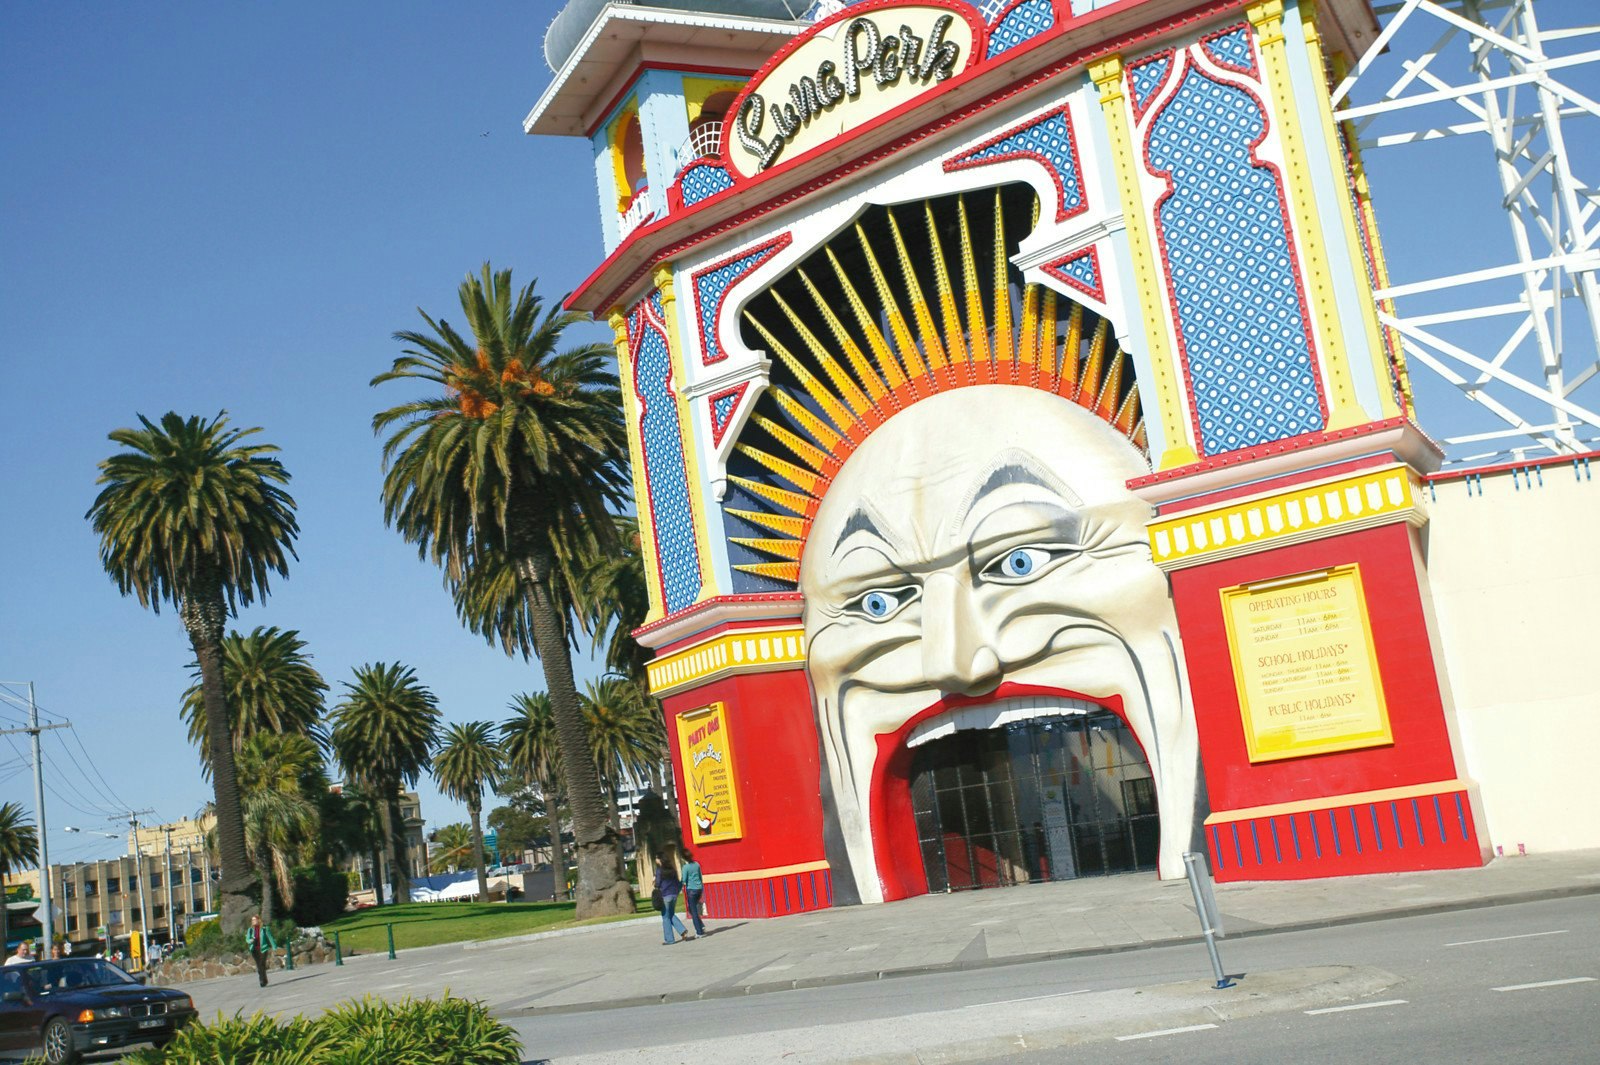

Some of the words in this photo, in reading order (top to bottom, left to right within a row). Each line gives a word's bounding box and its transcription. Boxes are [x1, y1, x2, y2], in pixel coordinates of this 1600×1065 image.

[737, 60, 844, 169] Luna
[844, 14, 960, 97] Park
[1248, 594, 1301, 612] OPERATING
[1303, 587, 1337, 602] HOURS
[1253, 623, 1282, 633] SATURDAY
[1297, 617, 1316, 626] 11AM
[1323, 613, 1337, 621] 6PM
[1254, 633, 1279, 643] SUNDAY
[1298, 627, 1318, 635] 11AM
[1258, 653, 1296, 668] SCHOOL
[1268, 701, 1303, 716] PUBLIC
[688, 725, 706, 749] PARTY
